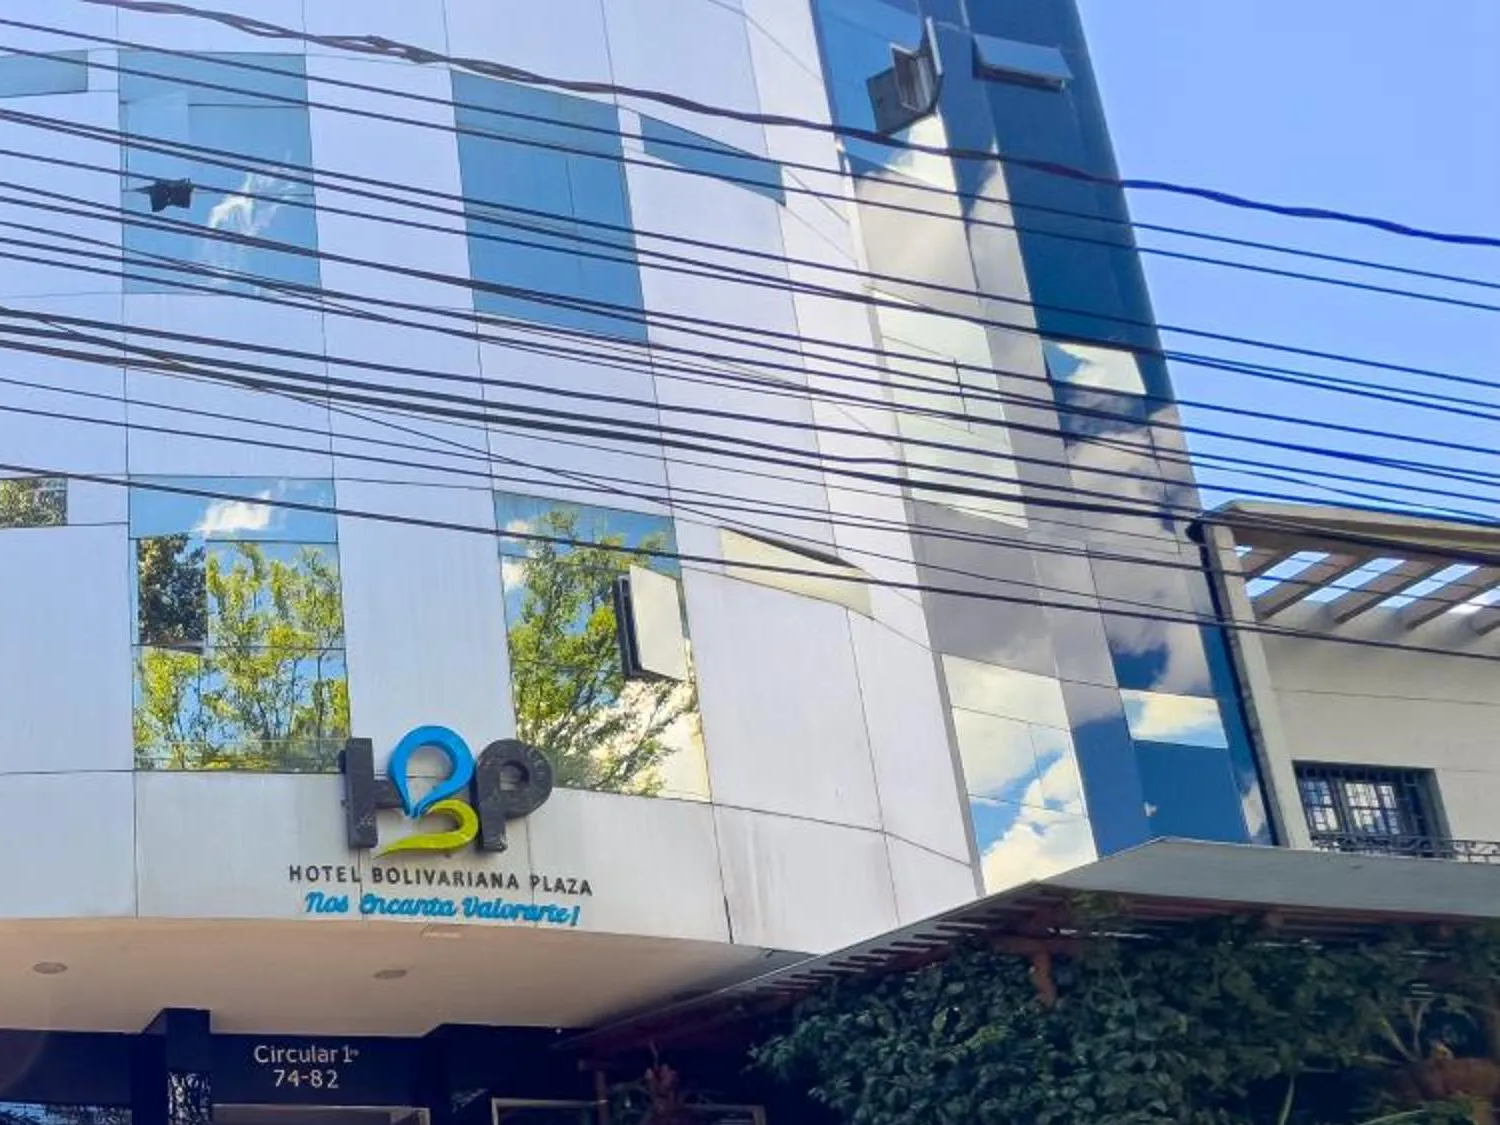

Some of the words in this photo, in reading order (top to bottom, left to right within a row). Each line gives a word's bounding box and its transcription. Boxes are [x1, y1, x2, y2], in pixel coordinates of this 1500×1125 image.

[289, 865, 361, 883] HOTEL
[372, 867, 519, 889] BOLIVARIANA
[531, 875, 593, 896] PLAZA
[304, 891, 349, 914] Nos
[253, 1044, 339, 1063] Circular
[273, 1069, 339, 1088] 74-82
